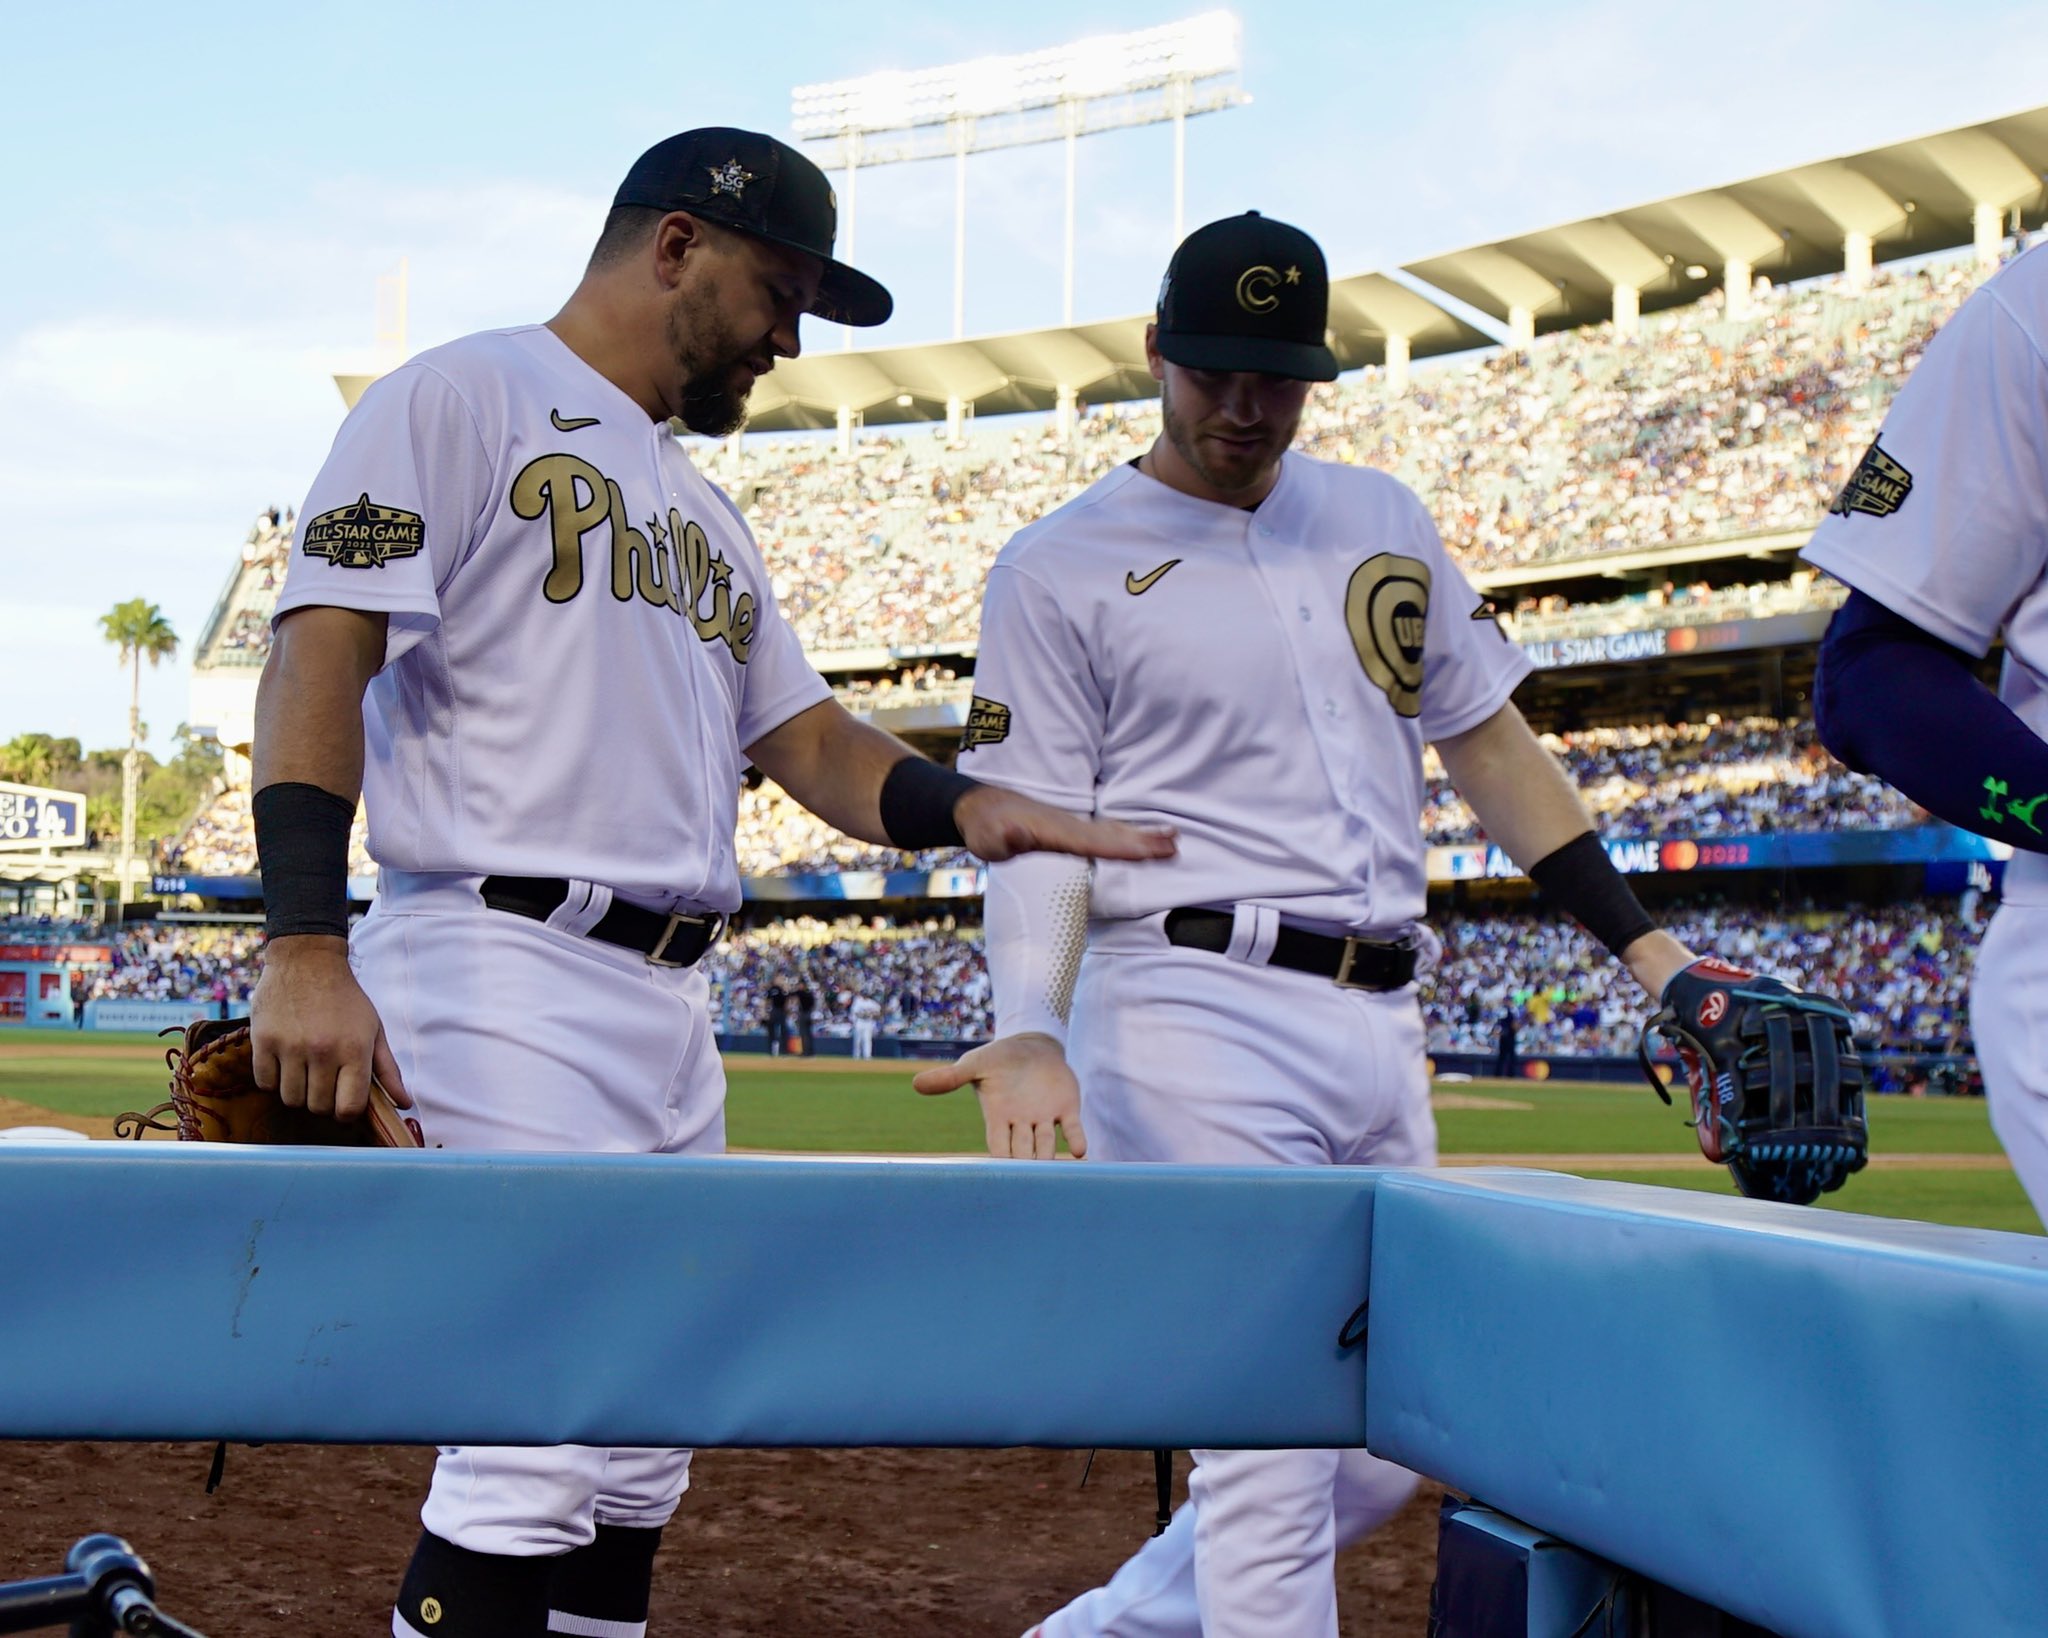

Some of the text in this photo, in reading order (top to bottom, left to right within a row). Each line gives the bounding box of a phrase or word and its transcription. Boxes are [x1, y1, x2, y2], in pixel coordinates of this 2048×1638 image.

[714, 173, 744, 189] ASG
[1236, 265, 1281, 314] C
[1859, 469, 1904, 504] GAME
[372, 523, 419, 542] GAME
[509, 452, 757, 665] Phillie
[1560, 635, 1605, 667] STAR
[1608, 628, 1667, 660] GAME
[969, 712, 1007, 731] GAME
